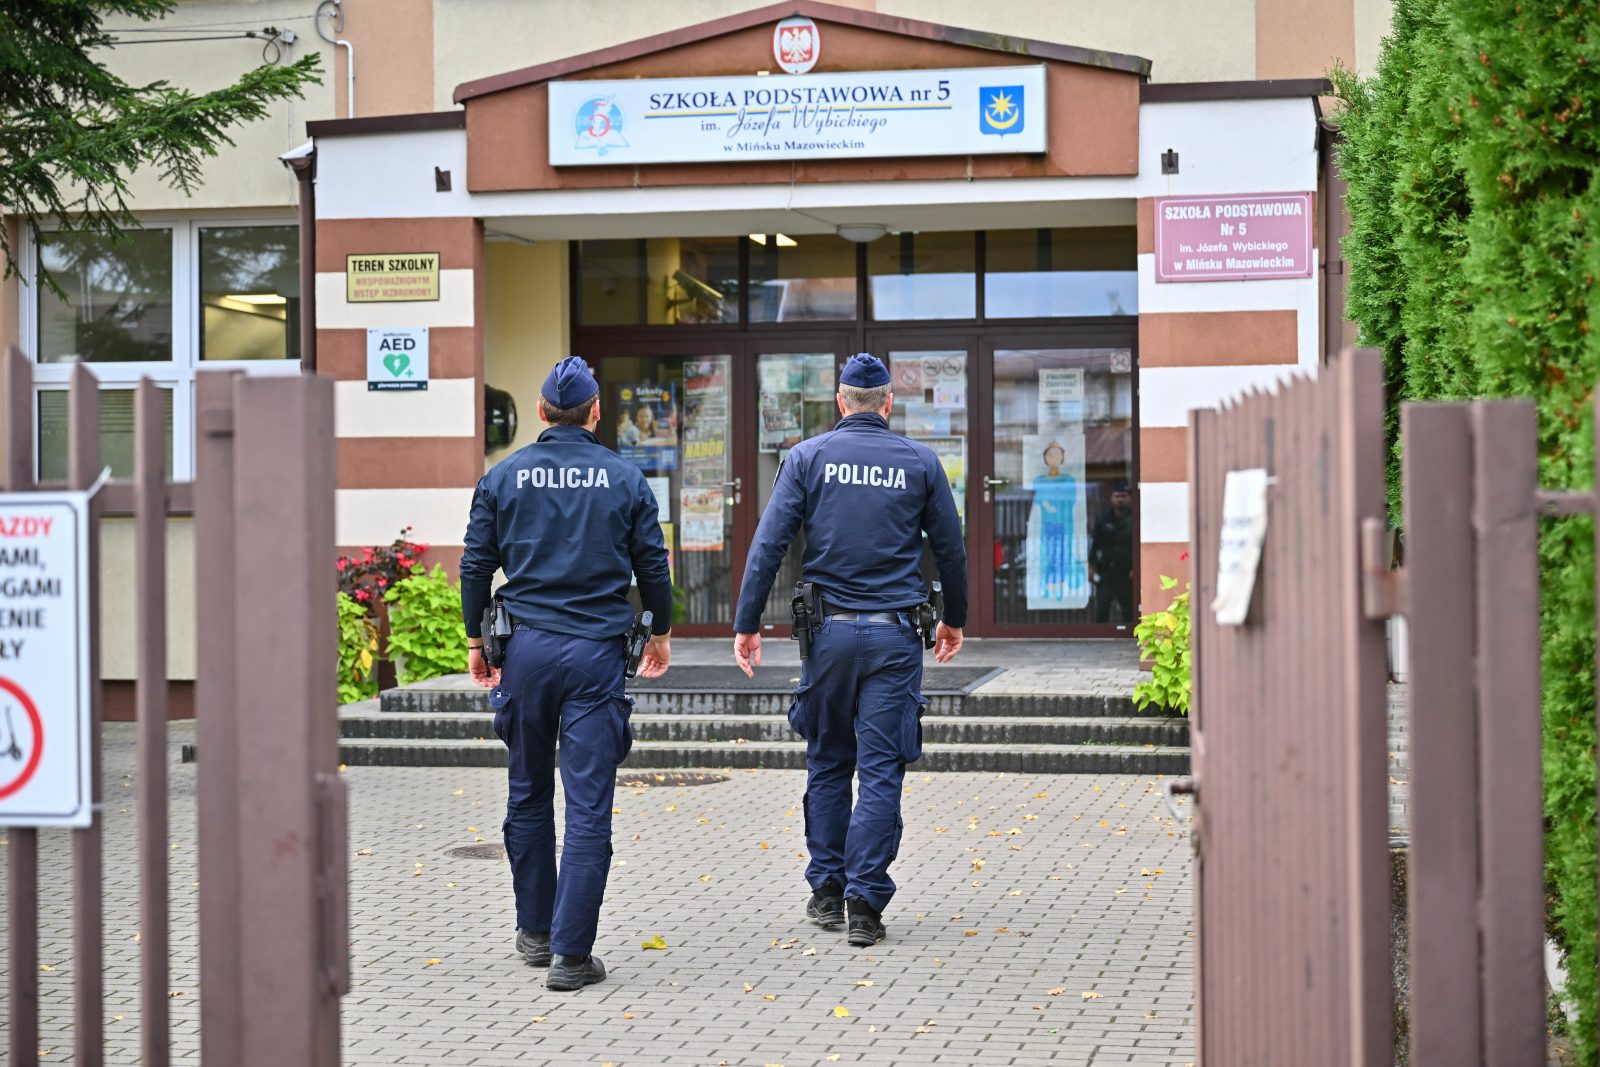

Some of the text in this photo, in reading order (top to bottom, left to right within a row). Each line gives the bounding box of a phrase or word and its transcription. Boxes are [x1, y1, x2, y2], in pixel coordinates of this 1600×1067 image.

[649, 80, 951, 111] SZKOŁA PODSTAWOWA nr 5
[700, 105, 888, 139] im. Józefa Wybickiego
[737, 141, 781, 152] Mińsku
[784, 139, 866, 150] Mazowieckim
[1165, 202, 1302, 220] SZKOŁA PODSTAWOWA
[1220, 222, 1247, 237] Nr 5
[1179, 241, 1288, 254] im. Józefa Wybickiego
[352, 258, 435, 272] TEREN SZKOLNY
[1174, 256, 1294, 271] w Mińsku Mazowieckim
[379, 338, 416, 350] AED
[516, 467, 610, 489] POLICJA
[824, 463, 907, 490] POLICJA
[0, 577, 62, 598] GAMI
